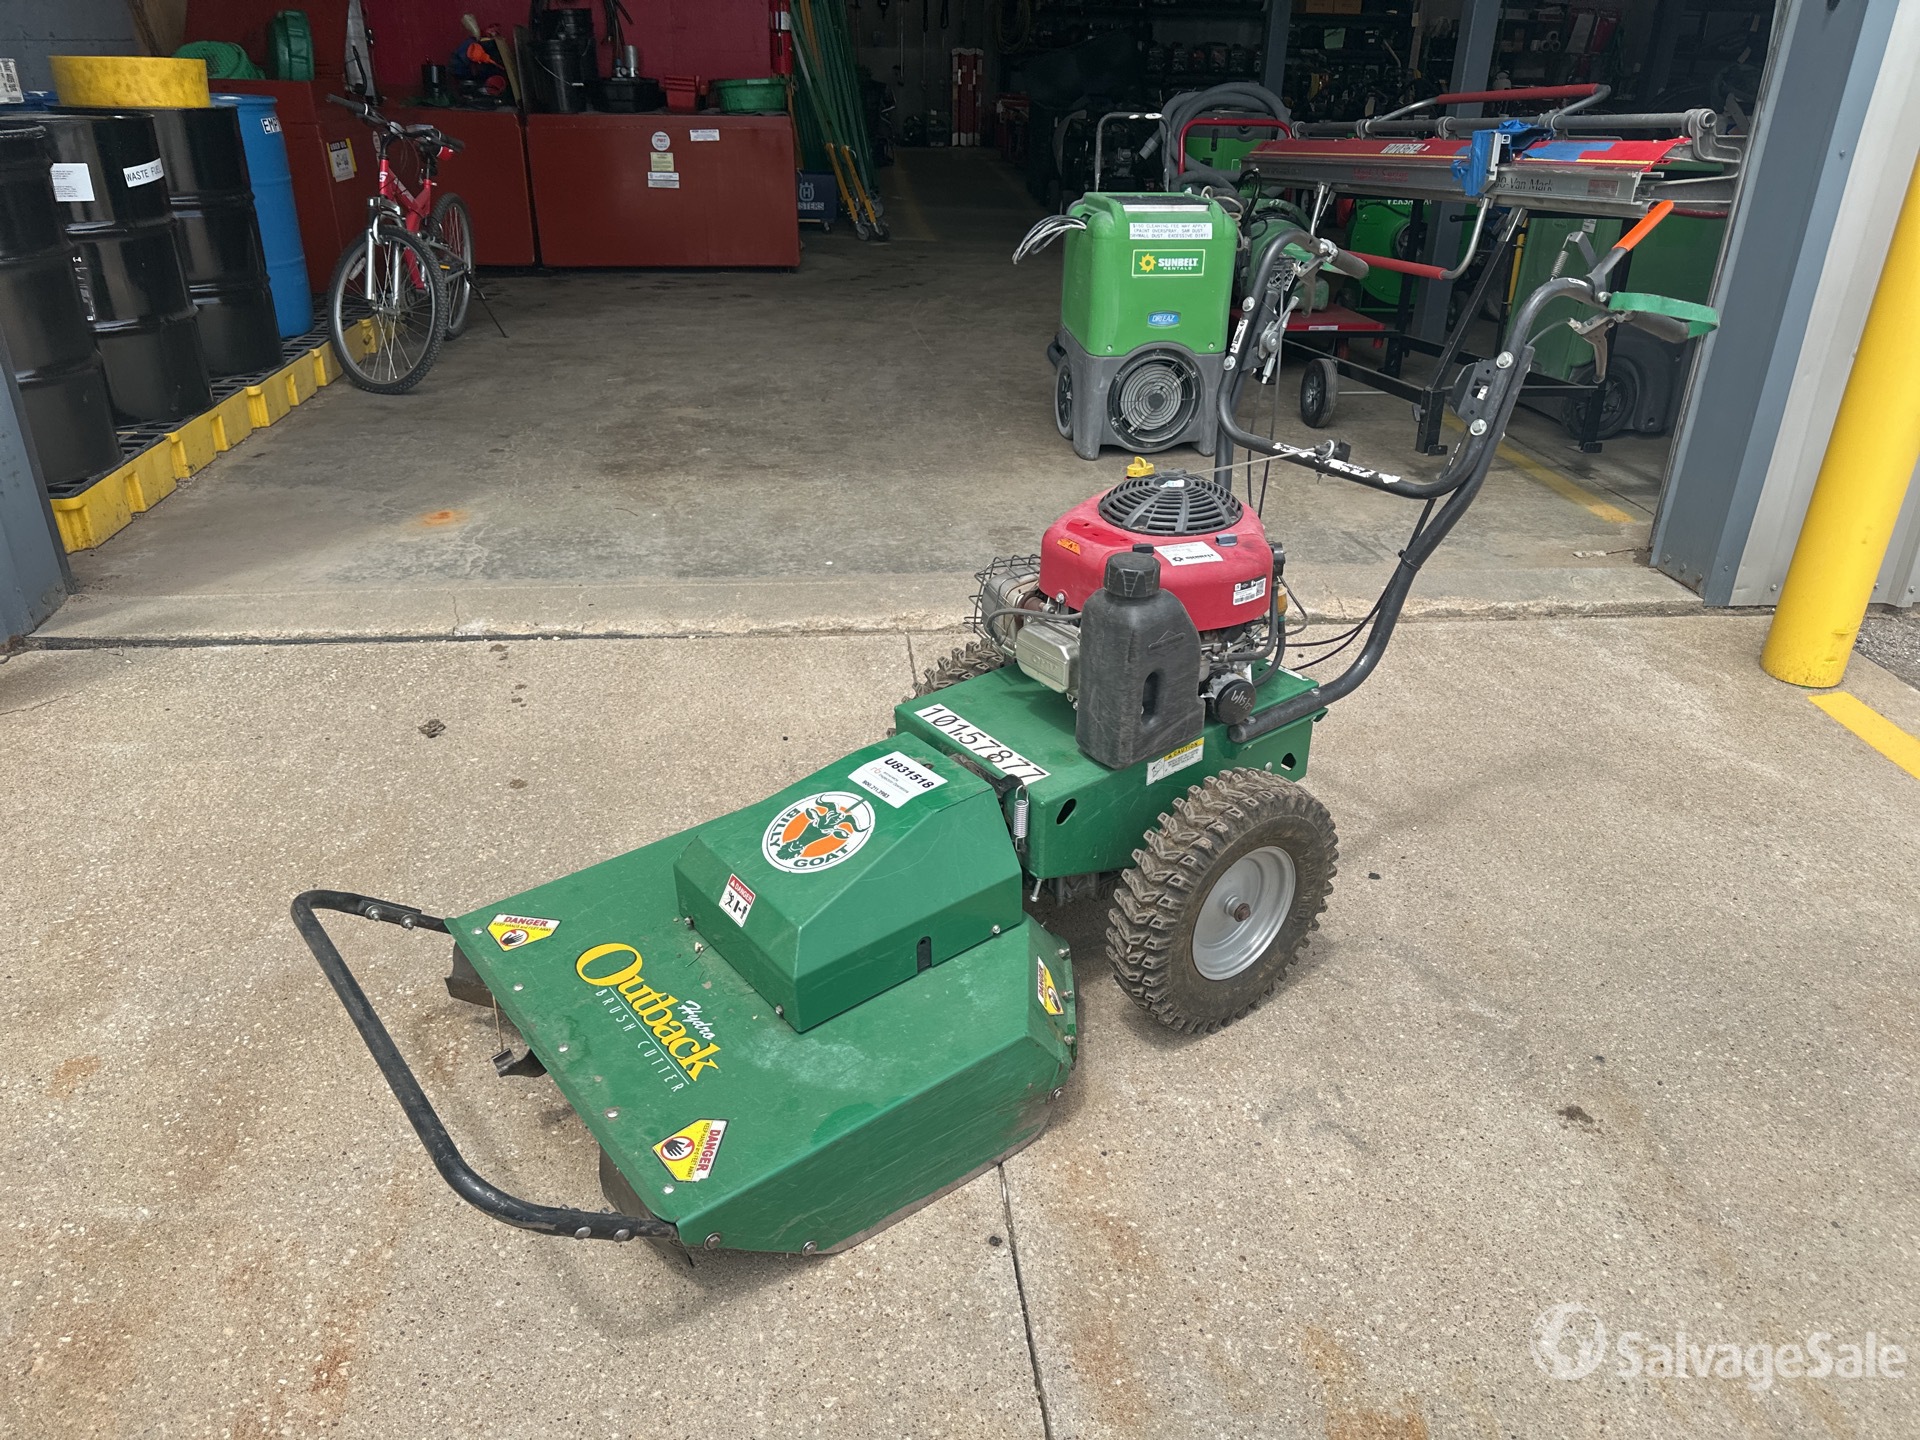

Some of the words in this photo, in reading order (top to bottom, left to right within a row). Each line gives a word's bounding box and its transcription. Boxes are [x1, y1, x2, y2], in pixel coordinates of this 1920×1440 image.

[126, 169, 150, 182] WASTE
[1529, 178, 1553, 192] Mark
[1158, 258, 1198, 266] SUNBELT
[1174, 742, 1198, 756] CAUTION
[884, 758, 934, 788] U831518
[770, 808, 800, 847] BILLY
[794, 844, 848, 868] GOAT
[734, 883, 752, 904] DANGER
[504, 916, 548, 926] DANGER
[575, 942, 721, 1082] Outback
[677, 1000, 716, 1040] Hydro
[595, 988, 636, 1032] BRUSH
[638, 1040, 684, 1092] CUTTER
[696, 1130, 721, 1172] DANGER
